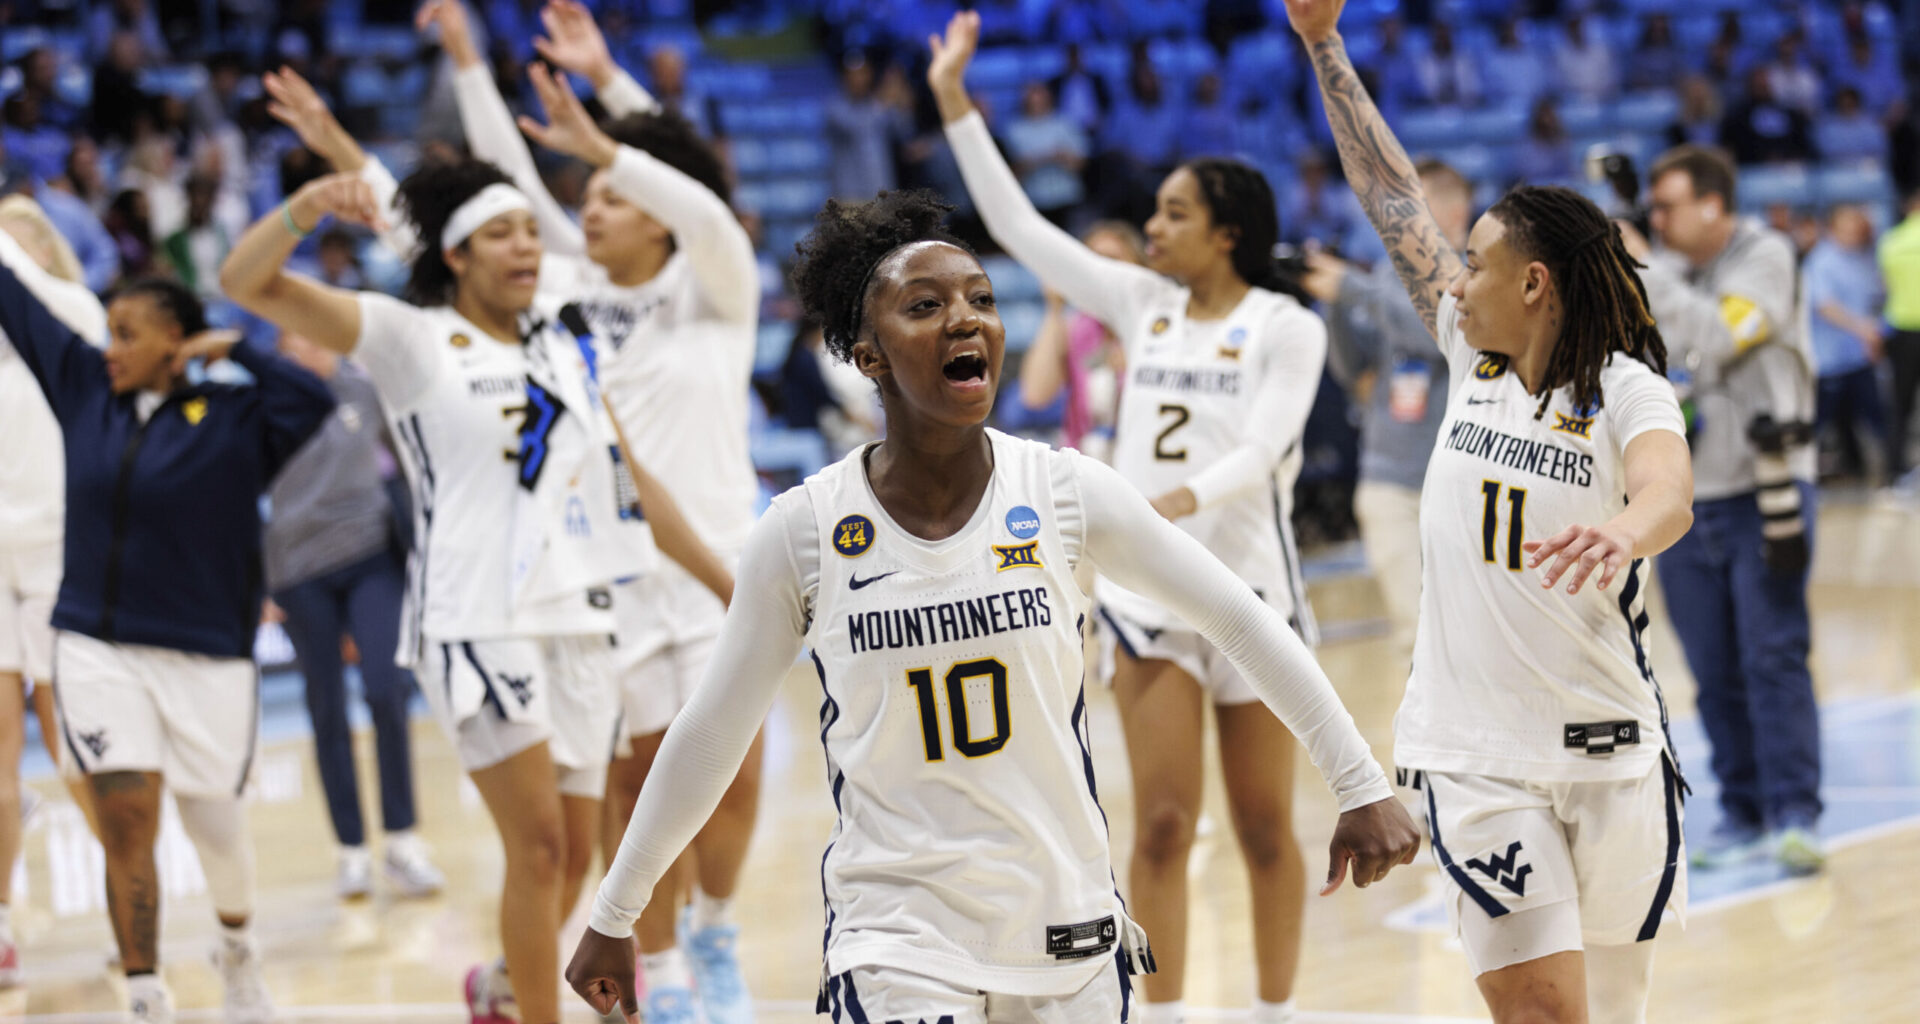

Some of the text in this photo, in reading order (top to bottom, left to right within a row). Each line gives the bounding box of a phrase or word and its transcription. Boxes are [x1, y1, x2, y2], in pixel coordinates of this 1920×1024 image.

[1154, 403, 1190, 462] 2
[1445, 419, 1593, 487] MOUNTAINEERS
[838, 528, 867, 548] 44
[841, 521, 865, 532] WEST
[1011, 519, 1040, 531] NCAA
[1481, 479, 1528, 572] 11
[992, 540, 1044, 572] XII
[848, 587, 1051, 654] MOUNTAINEERS
[905, 656, 1012, 763] 10
[1618, 727, 1630, 739] 42
[1103, 924, 1114, 937] 42
